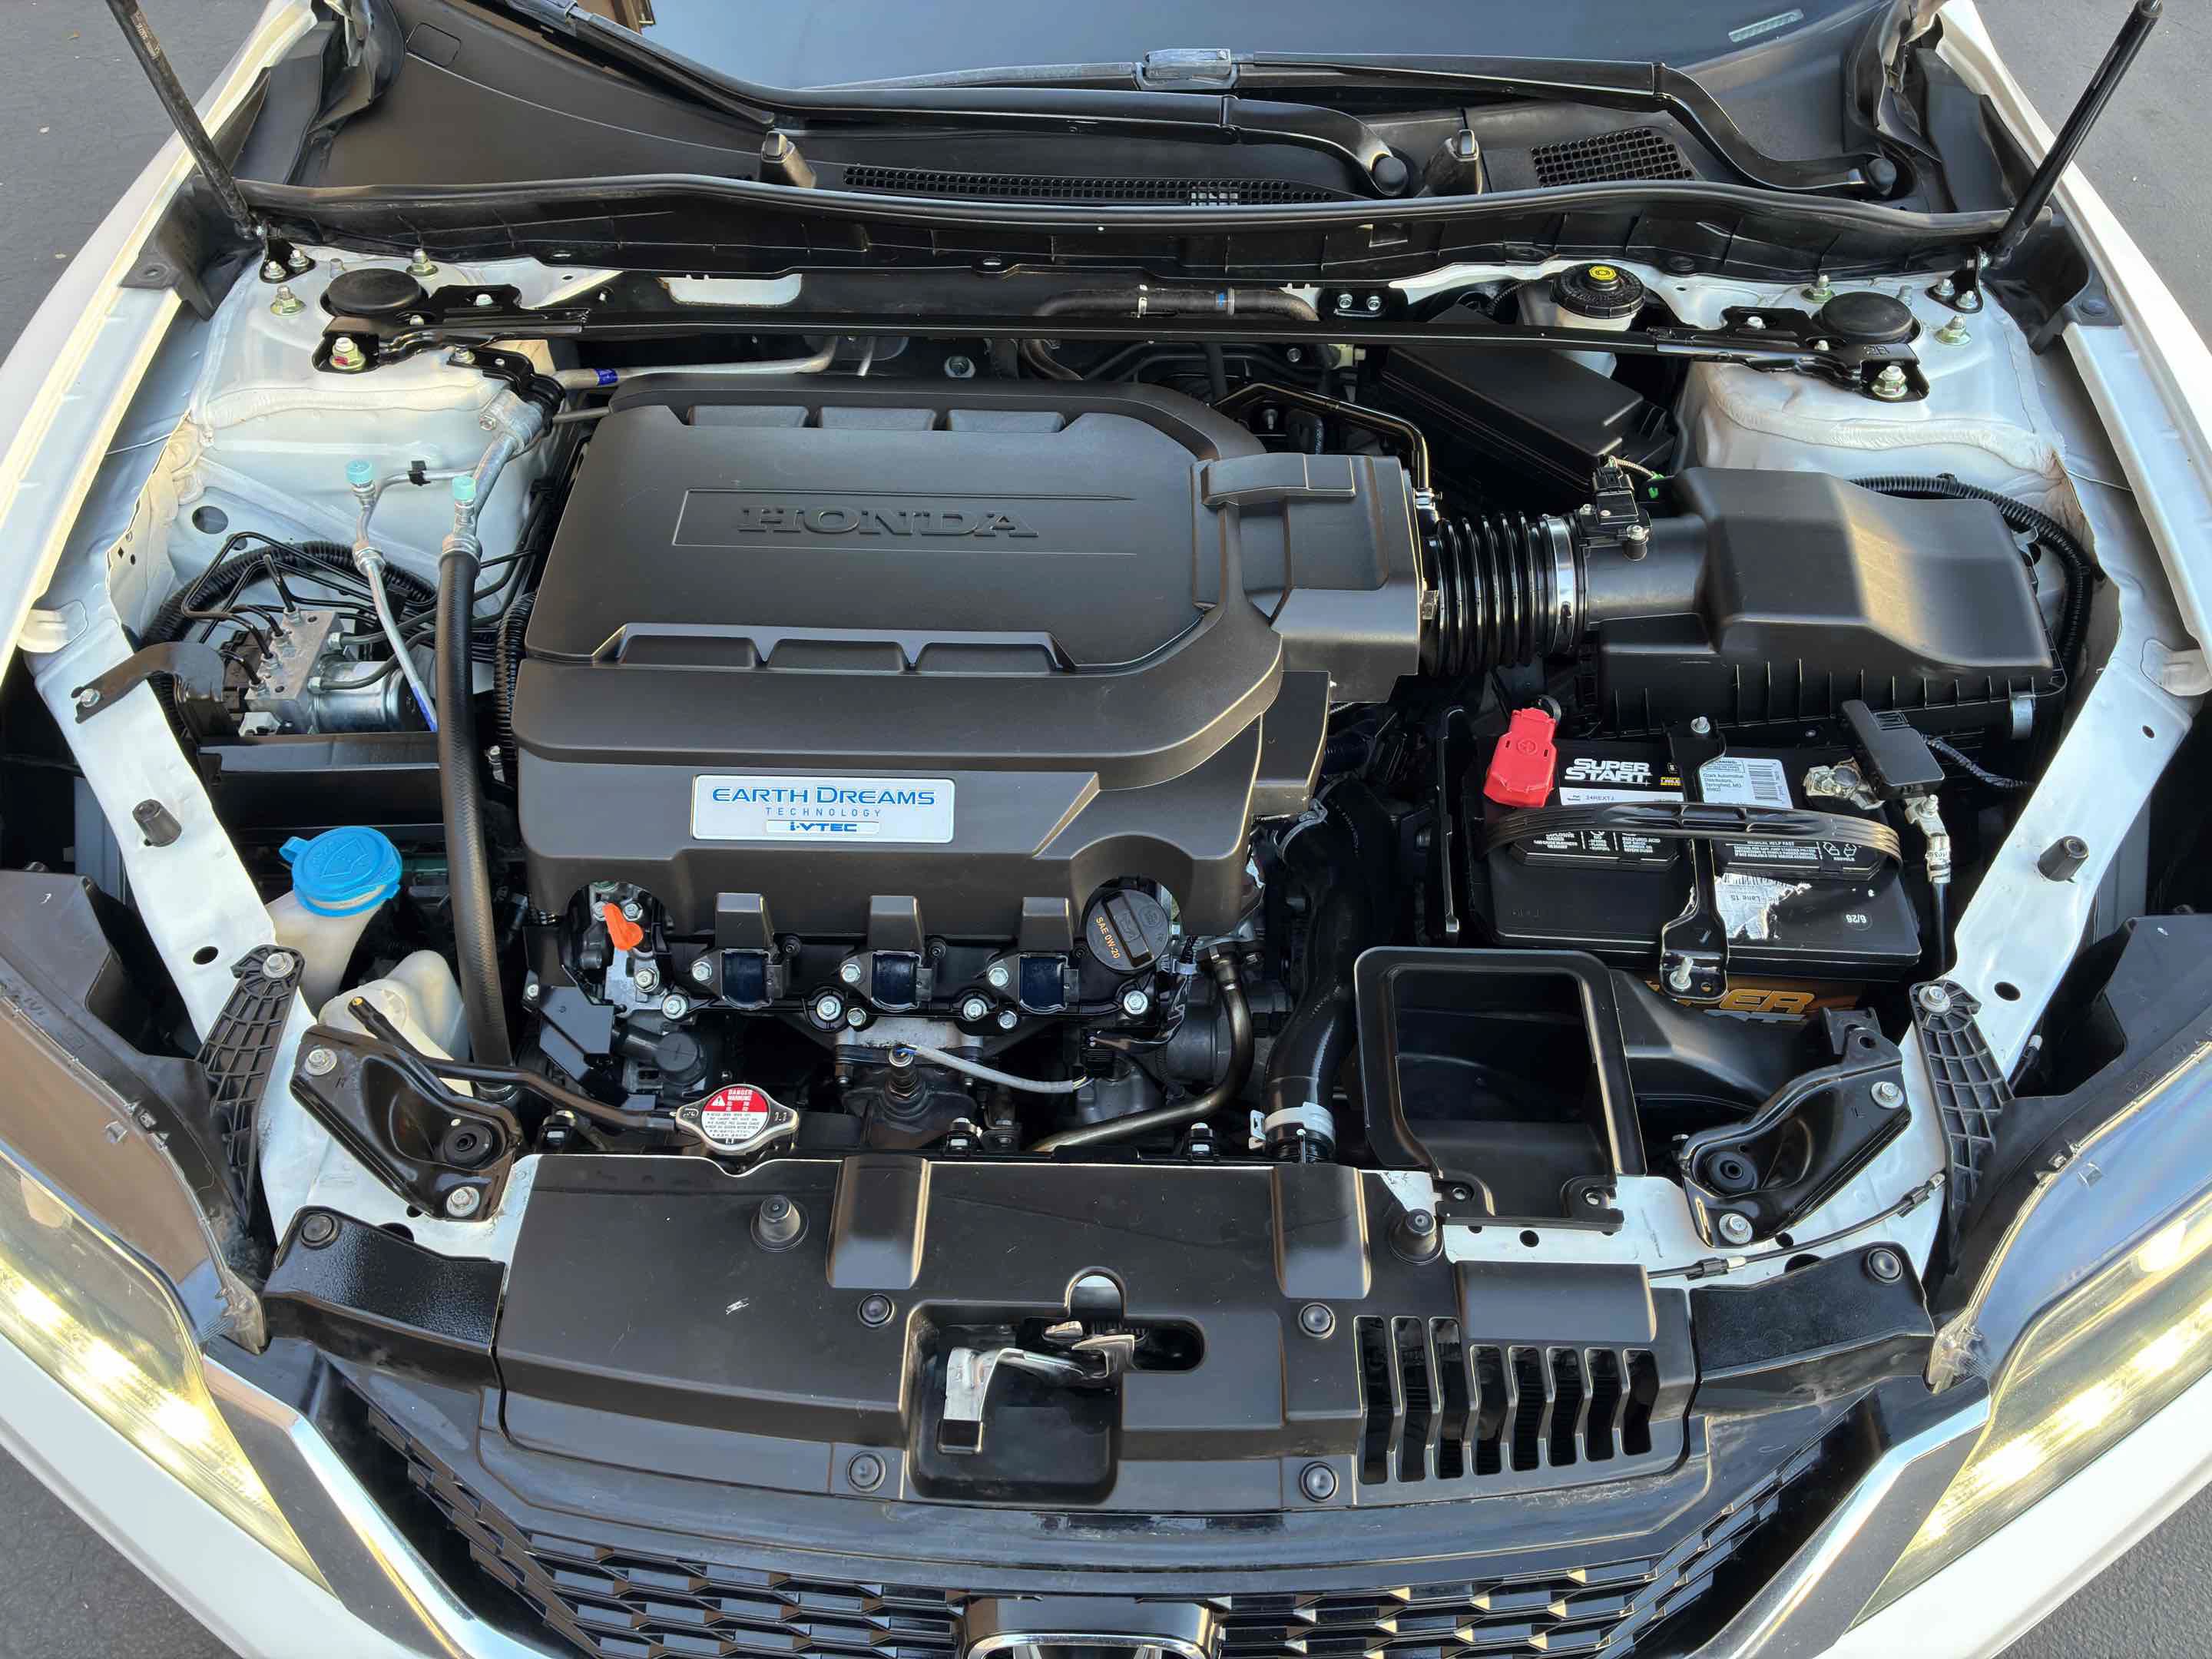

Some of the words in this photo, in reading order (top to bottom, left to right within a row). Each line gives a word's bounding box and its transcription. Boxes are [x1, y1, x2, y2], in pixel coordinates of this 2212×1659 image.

[737, 505, 1038, 538] HONDA
[1573, 758, 1650, 773] SUPER
[1565, 767, 1652, 782] START
[712, 786, 809, 803] EARTH
[816, 786, 935, 806] DREAMS
[766, 806, 882, 817] TECHNOLOGY
[1096, 916, 1108, 934] SAE
[1104, 934, 1120, 959] 0W-20
